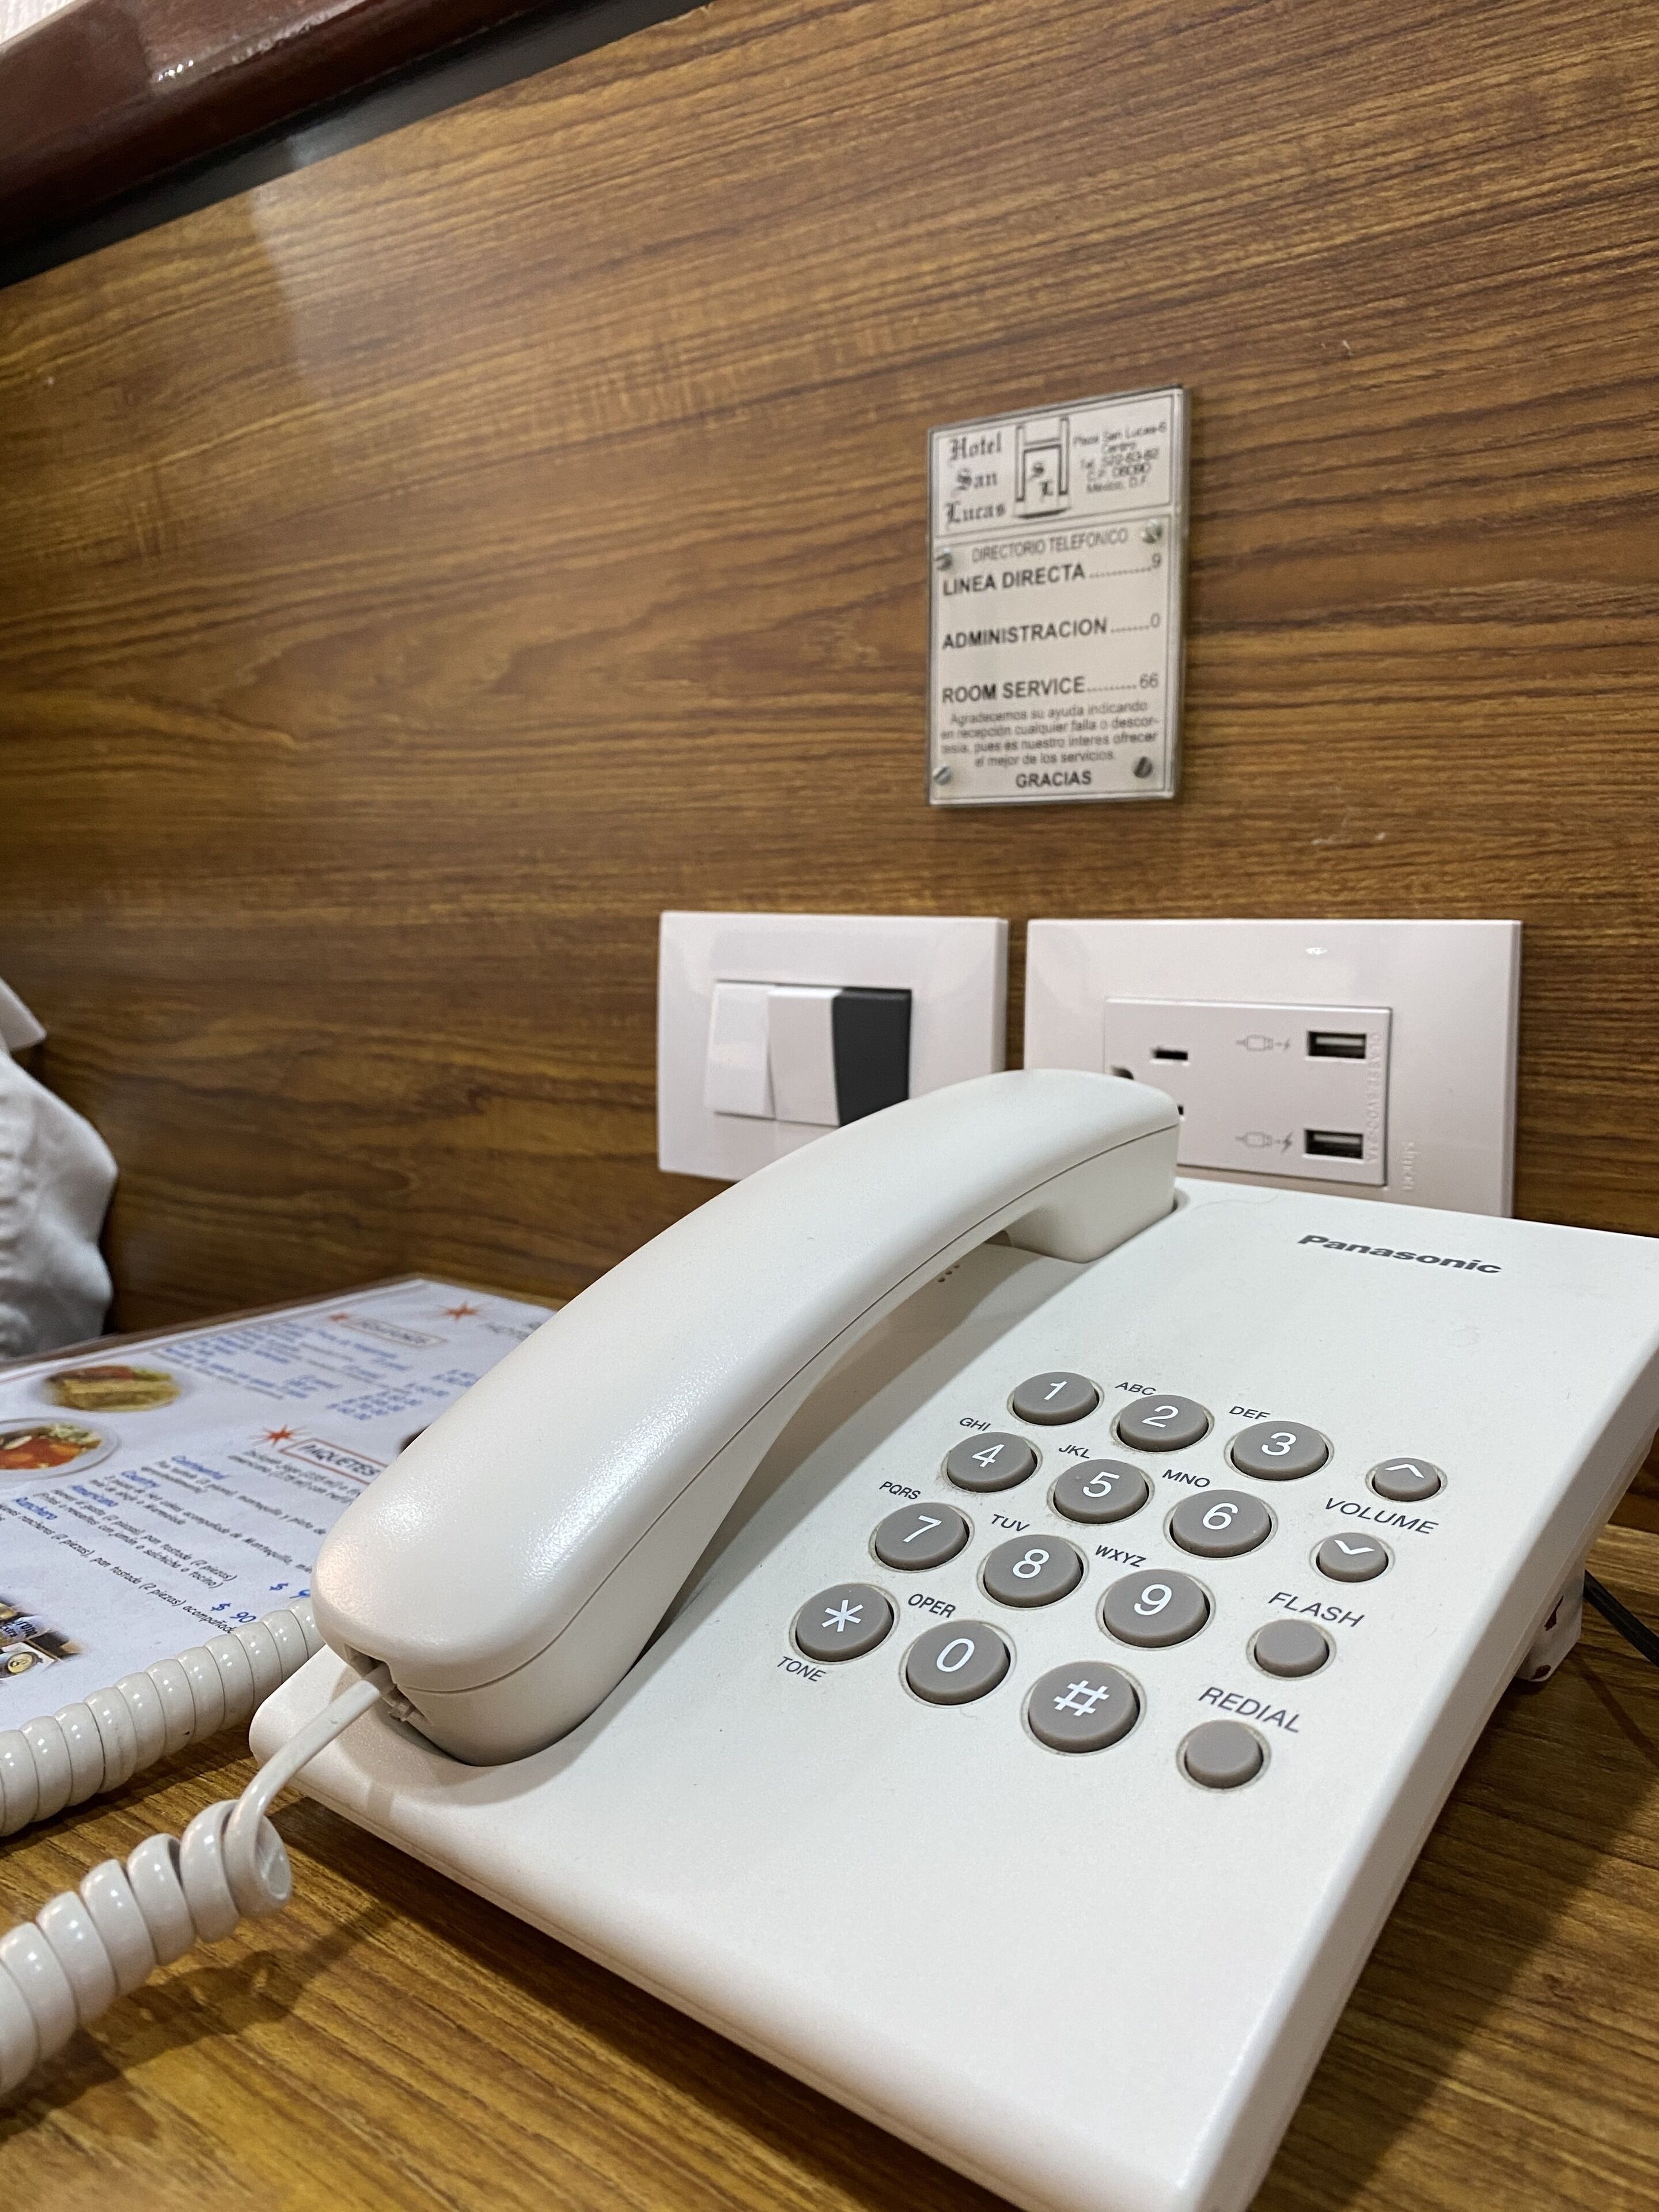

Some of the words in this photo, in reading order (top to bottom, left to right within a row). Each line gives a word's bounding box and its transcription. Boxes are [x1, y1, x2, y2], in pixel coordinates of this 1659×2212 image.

[948, 431, 1001, 463] Hotel
[953, 468, 997, 493] San
[946, 500, 1005, 524] Lucas
[972, 539, 1046, 563] DIRECTORIO
[1050, 528, 1129, 552] TELEFONICO
[943, 574, 995, 596] LINEA
[1002, 563, 1086, 589] DIRECTA
[942, 618, 1108, 650] ADMINISTRACION
[942, 684, 997, 704] ROOM
[1002, 676, 1086, 699] SERVICE
[1139, 673, 1158, 690] 66
[952, 711, 1027, 727] Agradecemos
[1031, 710, 1043, 719] su
[1048, 706, 1084, 720] ayuda
[1088, 701, 1147, 715] indicando
[941, 730, 954, 740] en
[1014, 724, 1068, 736] cualquier
[1071, 719, 1096, 731] falla
[1100, 721, 1108, 730] o
[975, 743, 1002, 755] pues
[1005, 741, 1017, 751] es
[1021, 738, 1065, 749] nuestro
[1113, 732, 1158, 744] ofrecer
[987, 756, 1019, 768] mejor
[1022, 753, 1036, 765] de
[1040, 752, 1056, 764] los
[1016, 771, 1092, 789] GRACIAS
[1298, 1235, 1501, 1273] Panasonic
[1044, 1381, 1067, 1400] 1
[1115, 1382, 1156, 1396] ABC
[959, 1417, 991, 1431] GHI
[1142, 1405, 1179, 1428] 2
[1229, 1406, 1271, 1419] DEF
[972, 1444, 1005, 1467] 4
[1058, 1444, 1090, 1459] JKL
[1262, 1432, 1297, 1456] 3
[878, 1481, 921, 1499] PQRS
[1083, 1471, 1120, 1498] 5
[1162, 1469, 1210, 1487] MNO
[991, 1514, 1031, 1532] TUV
[1202, 1503, 1238, 1530] 6
[1325, 1497, 1439, 1535] VOLUME
[903, 1515, 942, 1543] 7
[1013, 1549, 1050, 1578] 8
[1095, 1545, 1146, 1567] WXYZ
[143, 1550, 181, 1569] salchicha
[189, 1571, 224, 1589] tocino)
[199, 1565, 237, 1581] piezas)
[90, 1558, 111, 1567] pan
[110, 1566, 142, 1584] tostado
[147, 1588, 186, 1607] piezas)
[183, 1605, 236, 1634] acompañad
[270, 1583, 289, 1591] $
[908, 1593, 956, 1618] OPER
[1134, 1584, 1172, 1616] 9
[1268, 1592, 1365, 1627] FLASH
[211, 1603, 231, 1612] $
[229, 1612, 256, 1623] 90
[937, 1638, 975, 1672] 0
[776, 1656, 828, 1682] TONE
[1198, 1687, 1300, 1733] REDIAL
